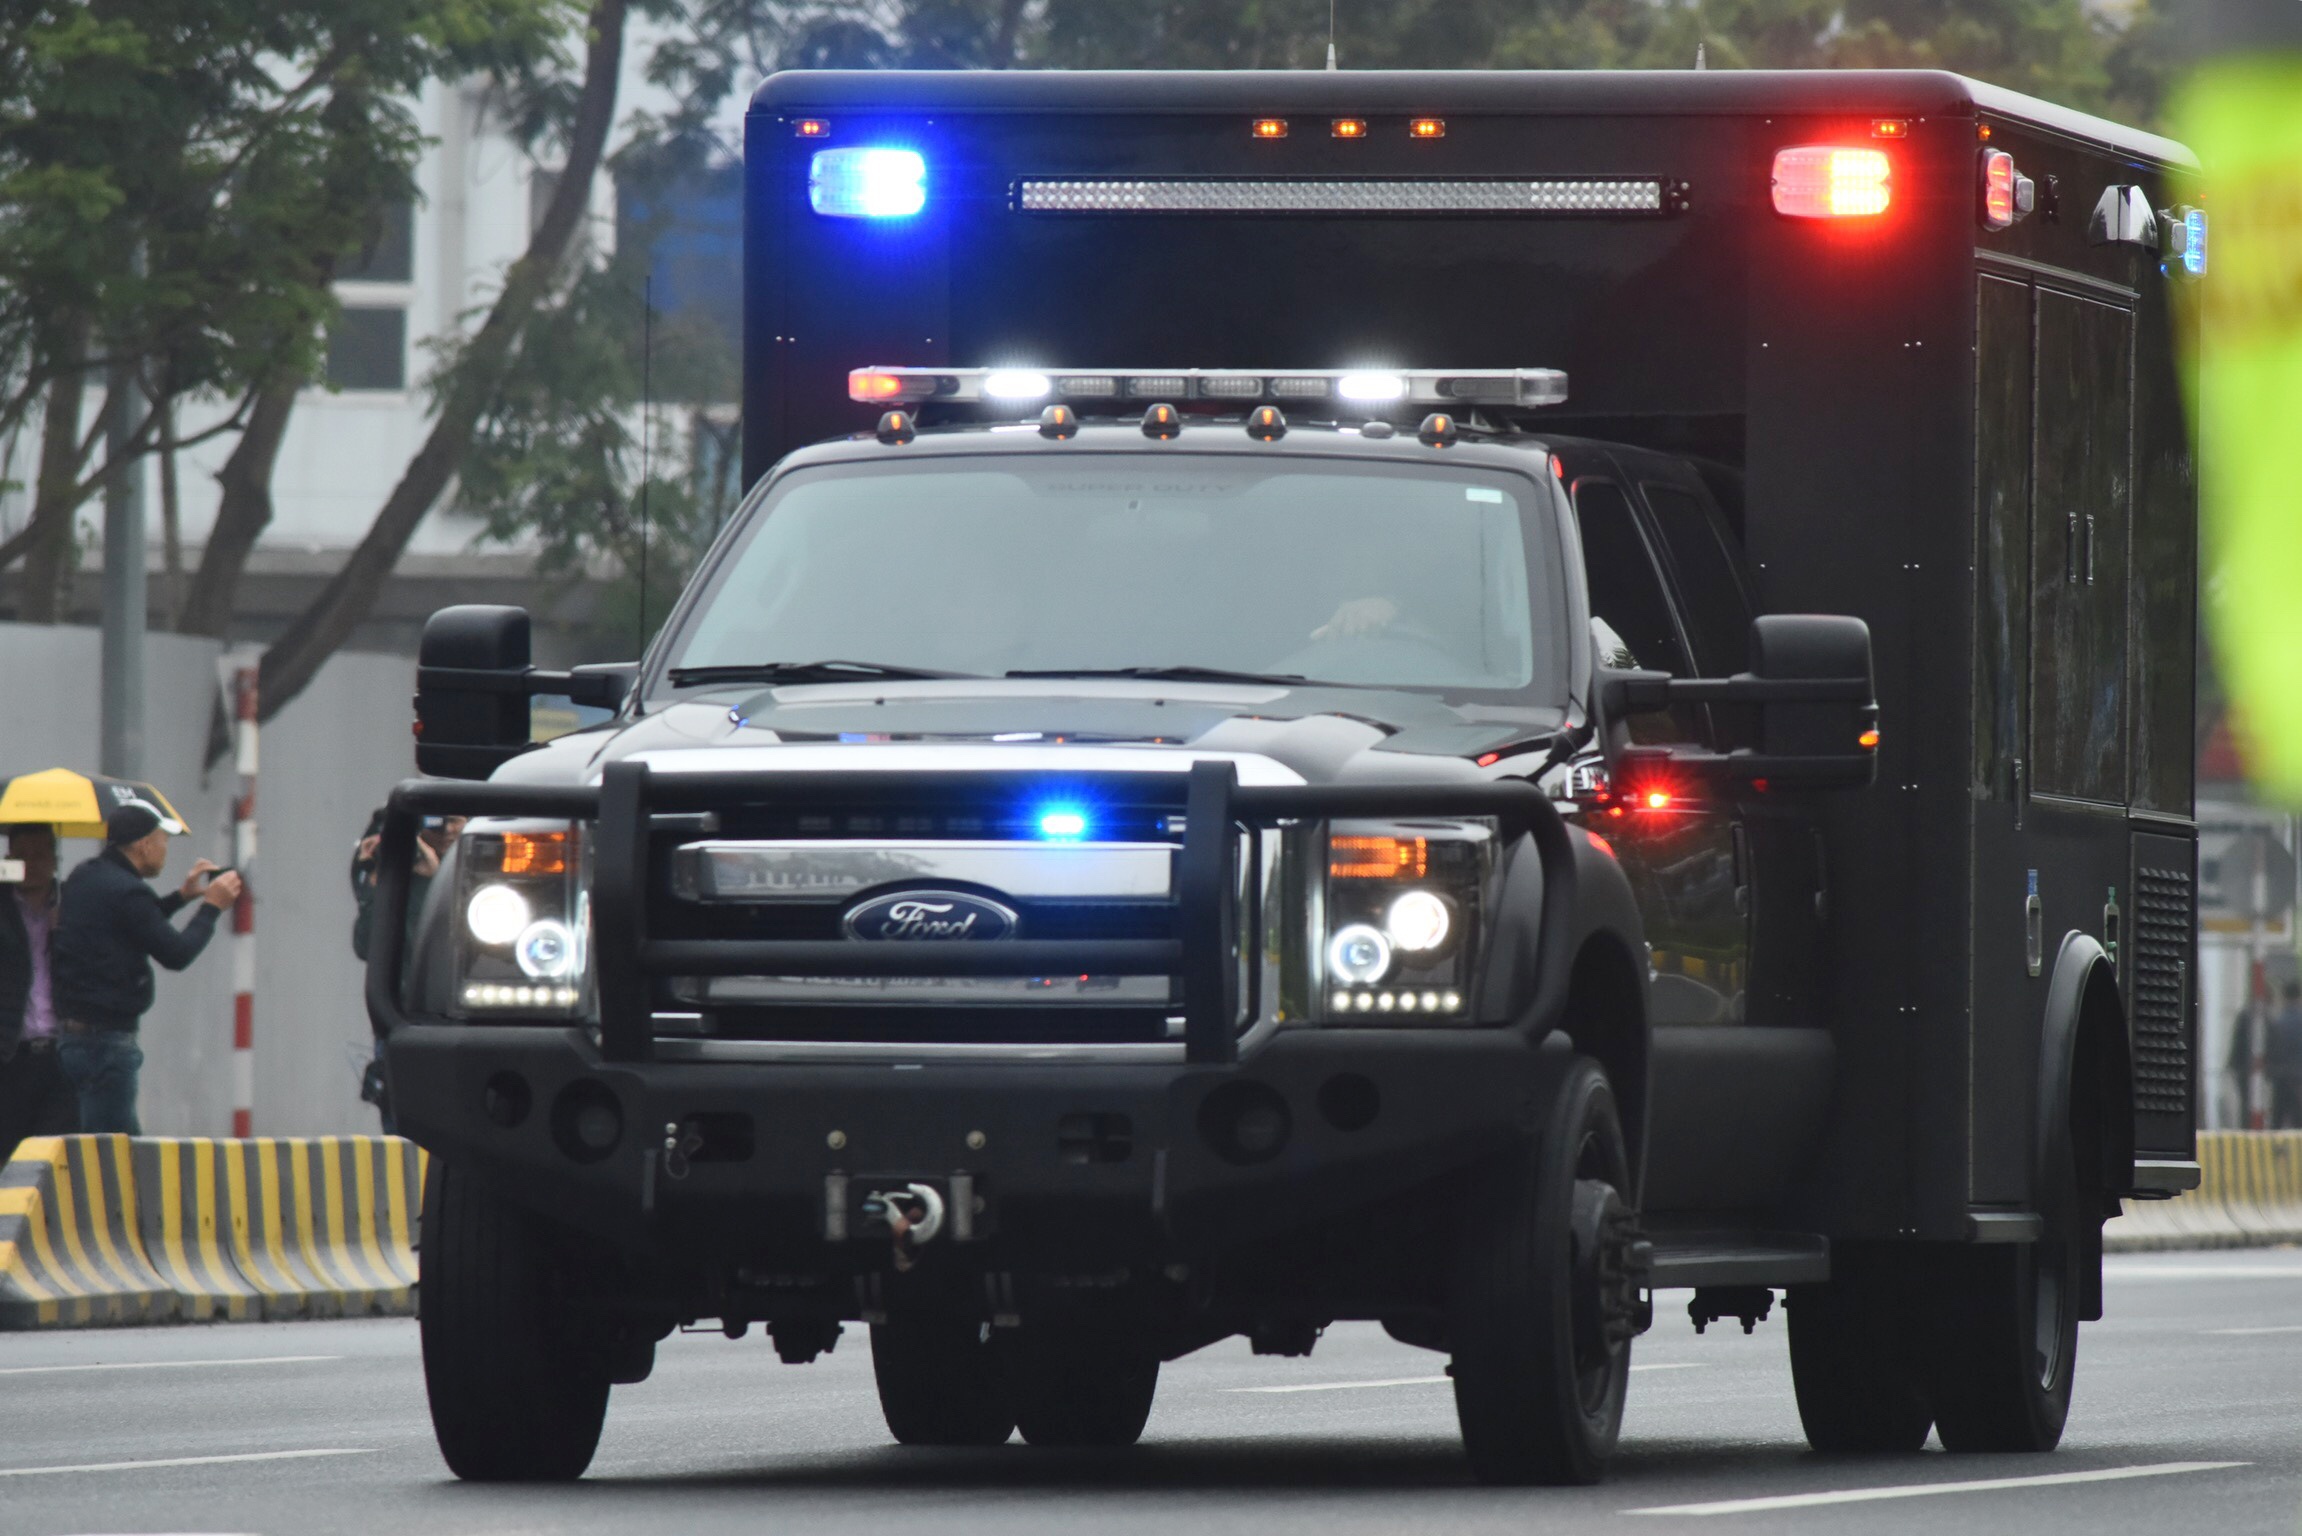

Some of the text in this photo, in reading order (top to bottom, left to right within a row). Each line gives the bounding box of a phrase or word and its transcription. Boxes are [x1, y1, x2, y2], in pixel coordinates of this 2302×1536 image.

[1047, 481, 1232, 493] SUPER DUTY
[880, 900, 978, 938] Ford
